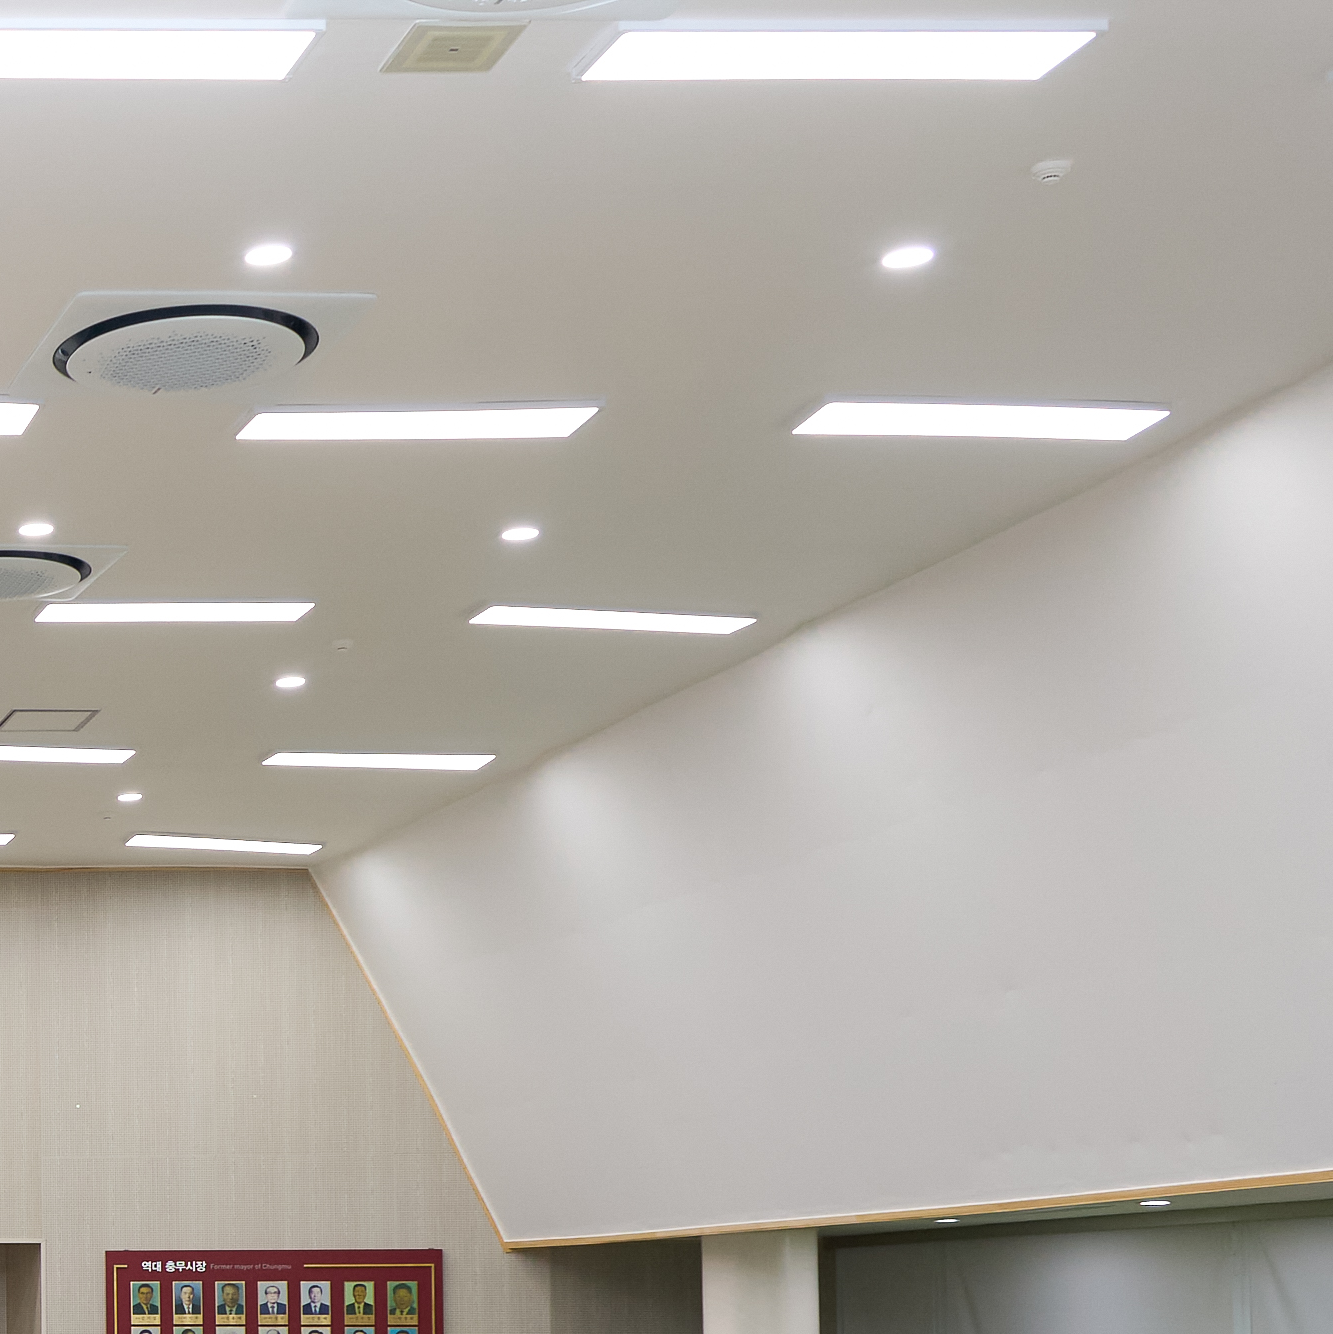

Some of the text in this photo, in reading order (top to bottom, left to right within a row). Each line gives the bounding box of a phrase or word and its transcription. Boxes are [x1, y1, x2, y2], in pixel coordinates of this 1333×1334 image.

[141, 1260, 162, 1272] 역대
[165, 1260, 206, 1273] 충무시장
[262, 1263, 292, 1271] Chungmu
